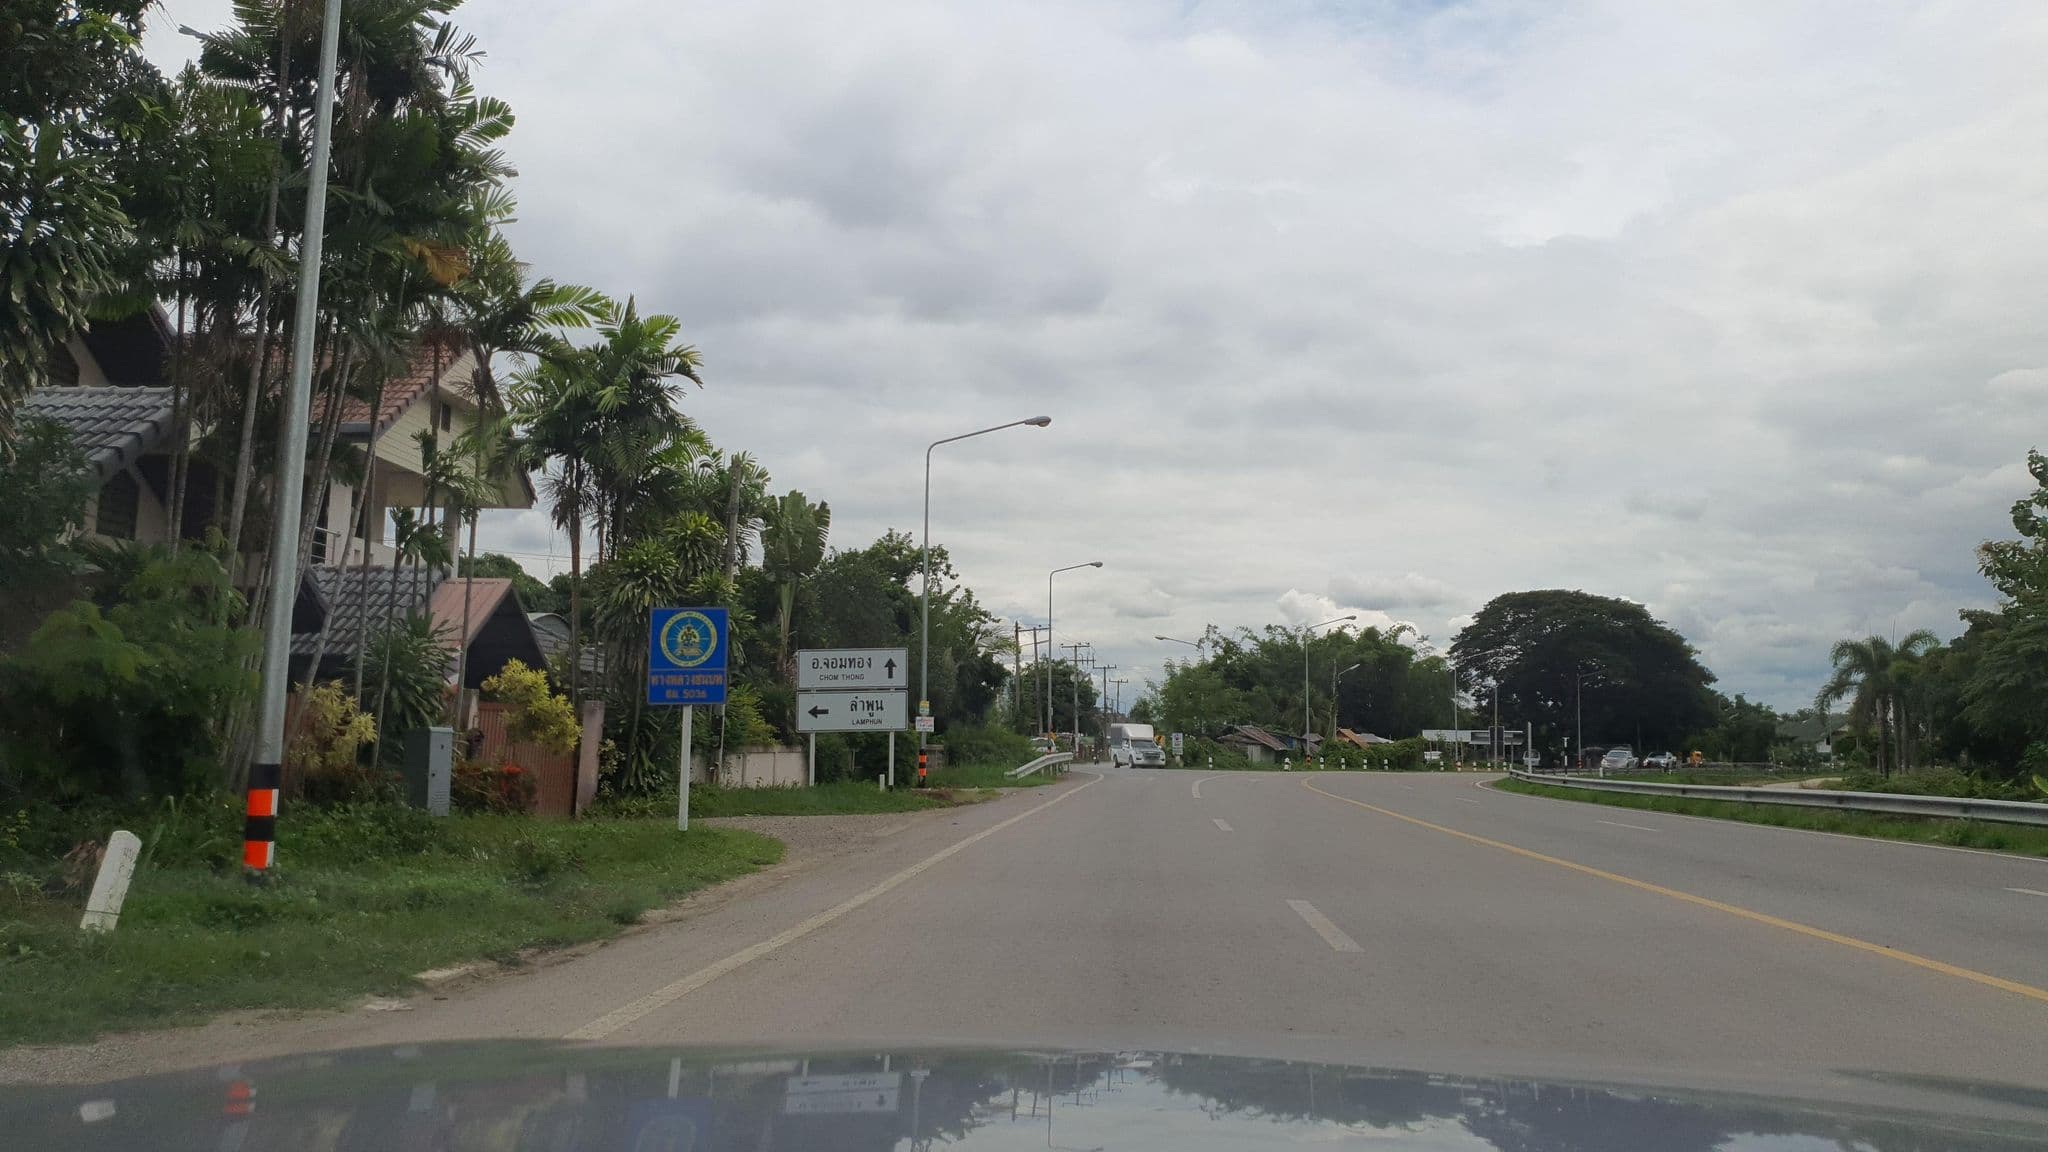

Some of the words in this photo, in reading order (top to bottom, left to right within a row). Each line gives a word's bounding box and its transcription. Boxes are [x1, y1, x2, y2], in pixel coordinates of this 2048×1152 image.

[812, 657, 872, 669] อ.จอมทอง
[842, 673, 865, 681] THONG
[851, 696, 884, 717] ลำพูน
